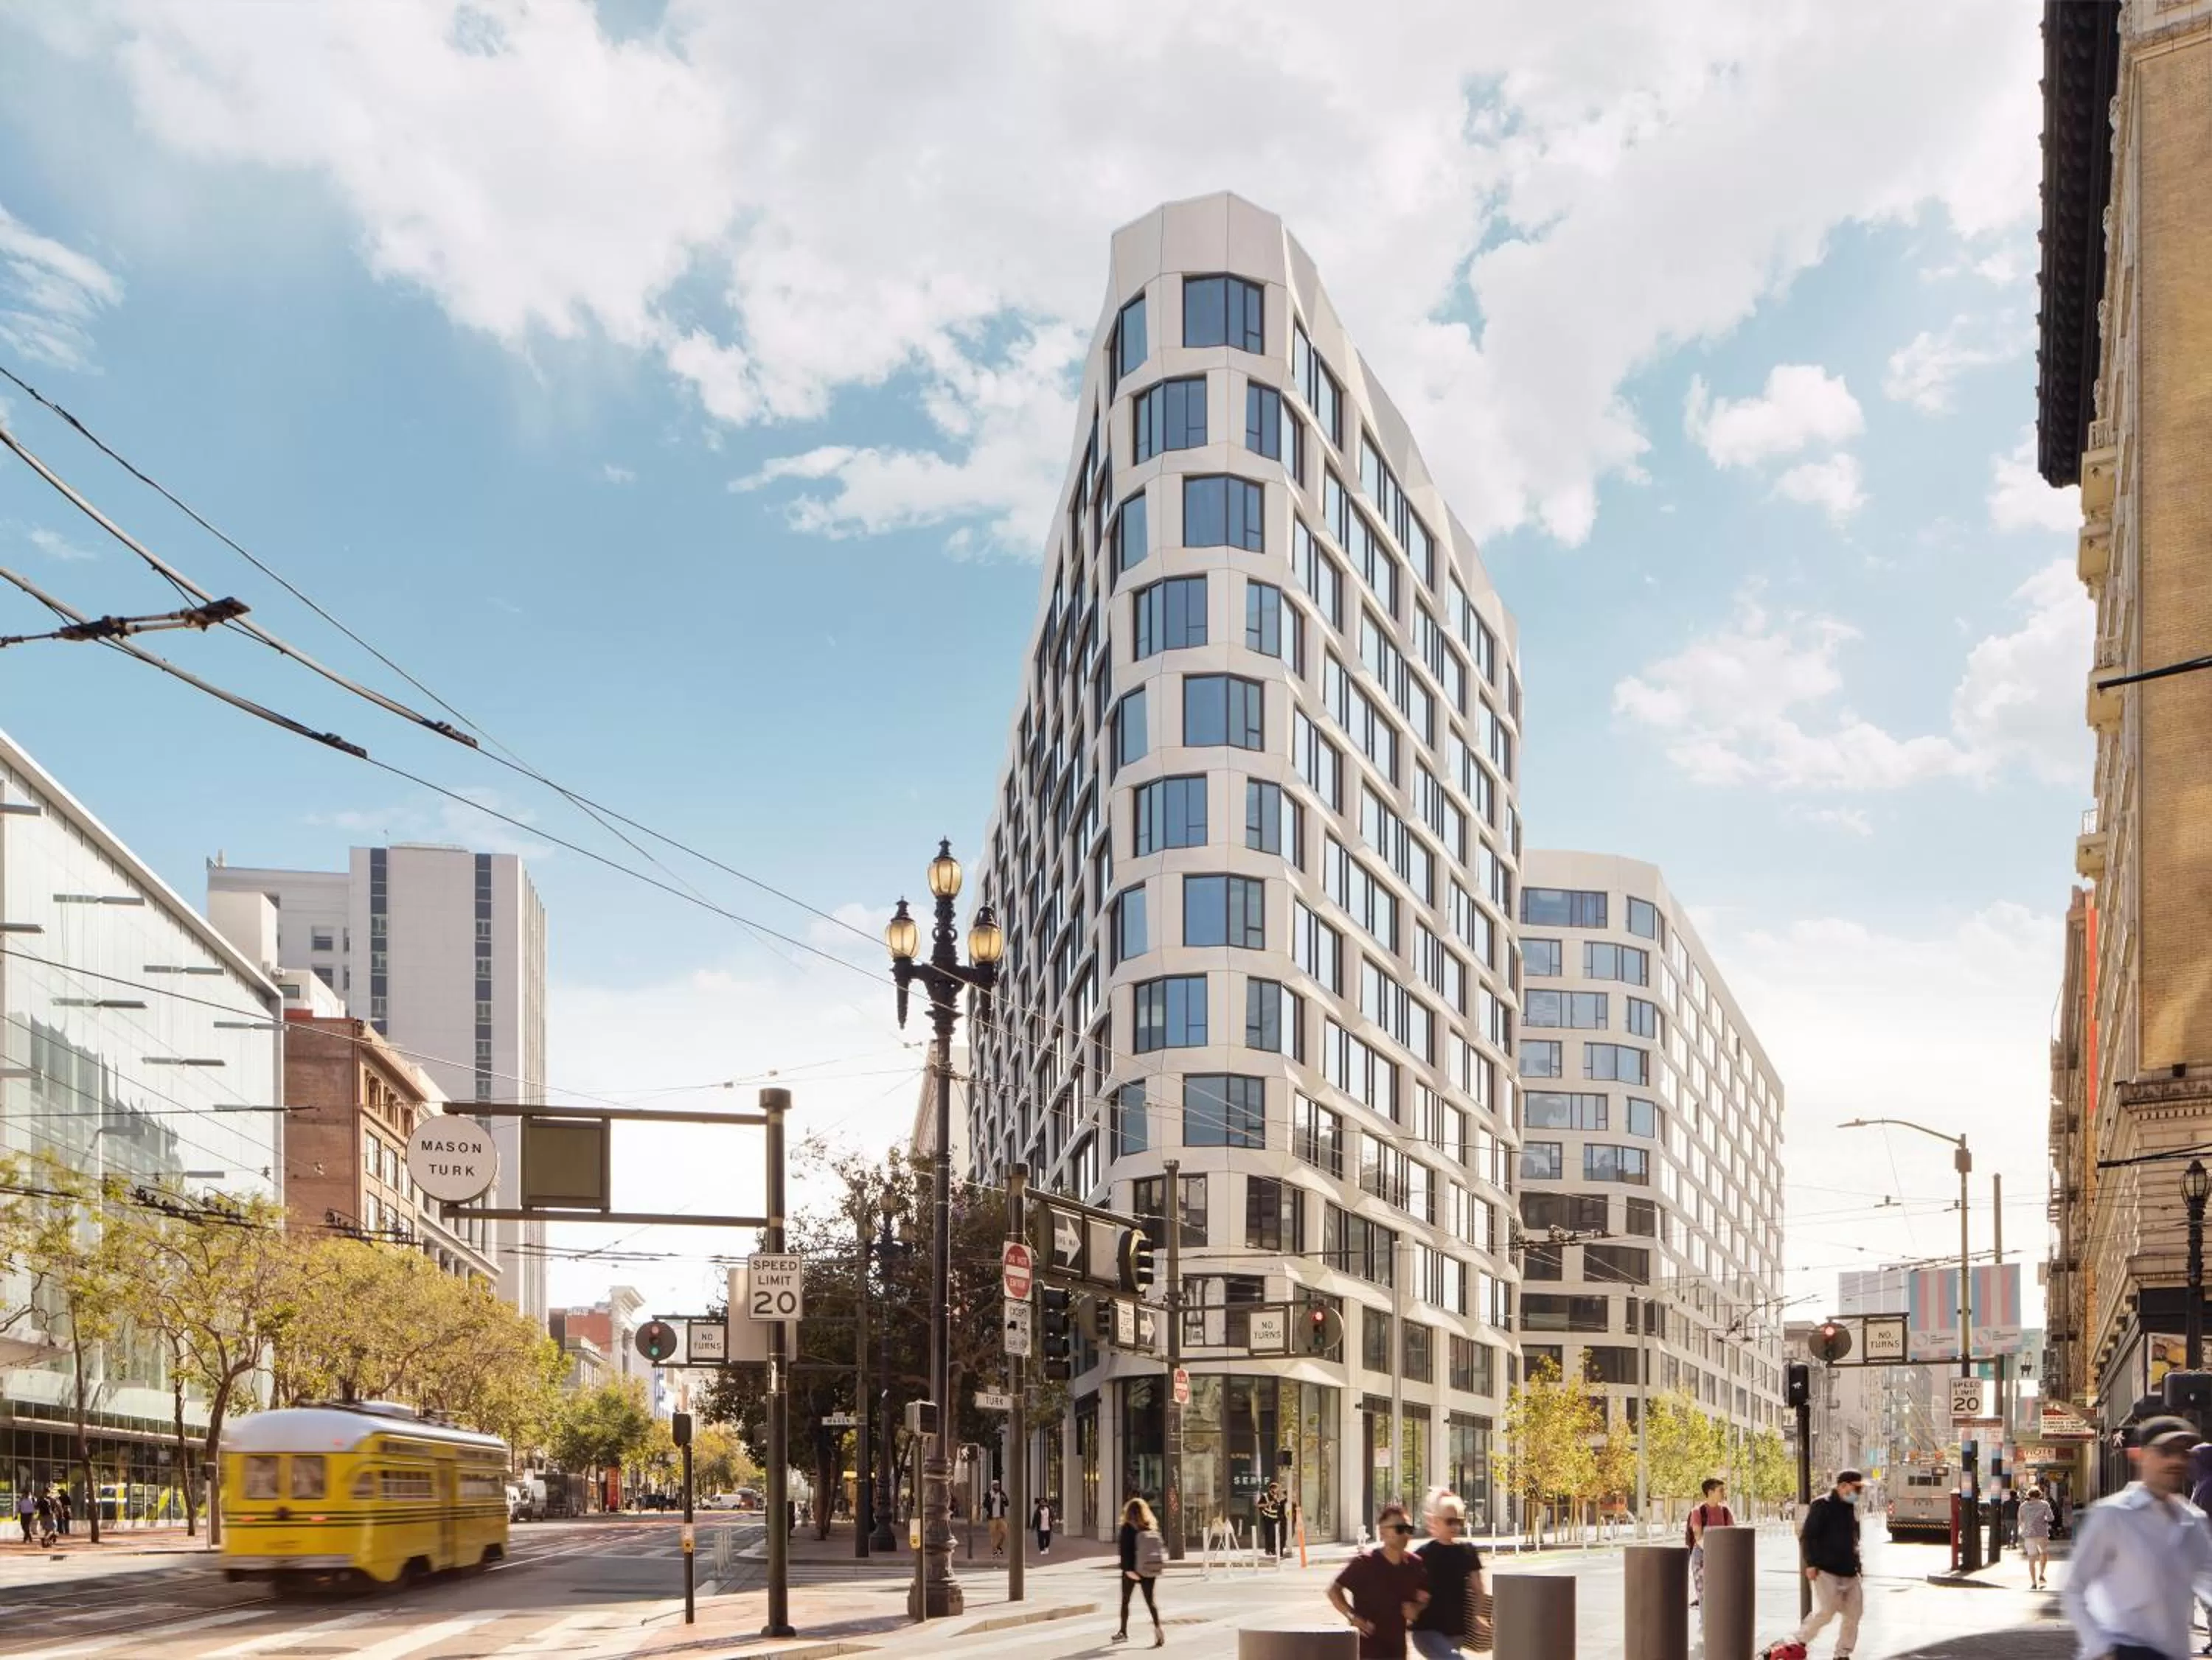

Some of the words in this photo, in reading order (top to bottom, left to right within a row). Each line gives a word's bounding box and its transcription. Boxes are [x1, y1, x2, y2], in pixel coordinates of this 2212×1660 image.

[421, 1140, 482, 1154] MASON
[428, 1163, 475, 1177] TURK
[752, 1260, 798, 1272] SPEED
[757, 1275, 792, 1286] LIMIT
[753, 1290, 797, 1315] 20
[1262, 1320, 1273, 1330] NO
[701, 1333, 714, 1342] NO
[1253, 1330, 1281, 1340] TURNS
[1877, 1331, 1892, 1340] NO
[694, 1342, 722, 1351] TURNS
[1871, 1339, 1900, 1349] TURNS
[1953, 1397, 1979, 1411] 20
